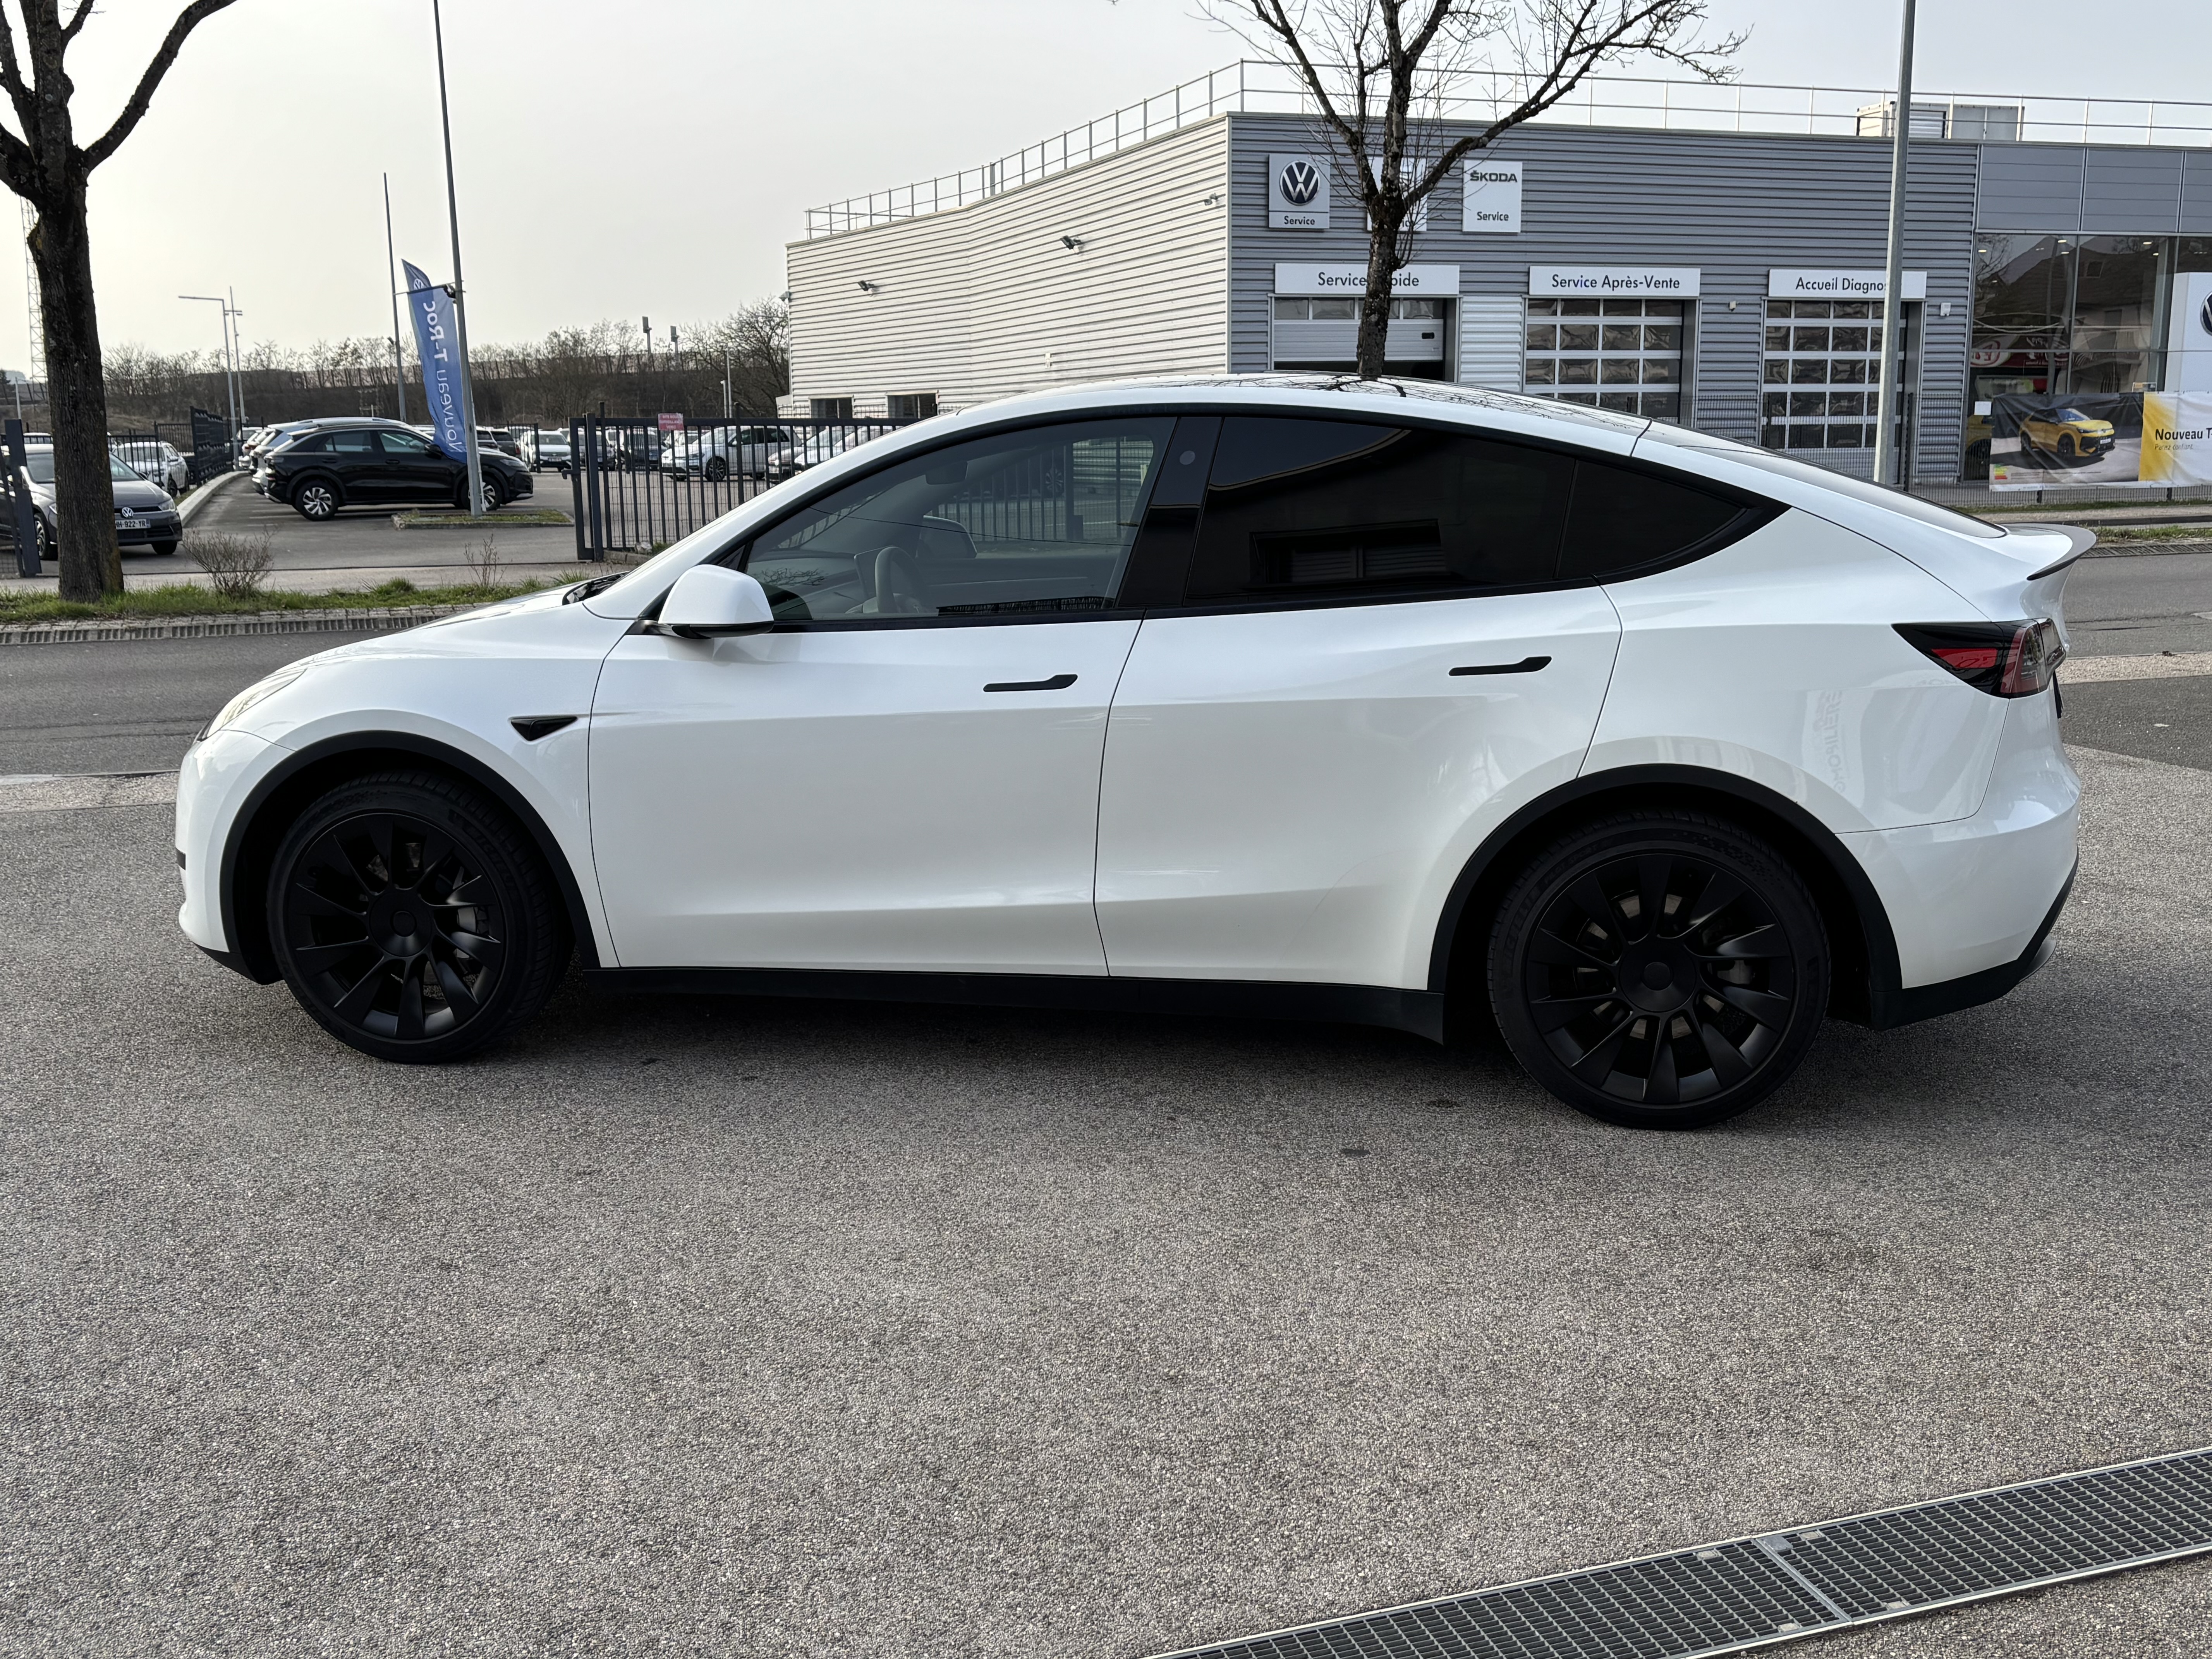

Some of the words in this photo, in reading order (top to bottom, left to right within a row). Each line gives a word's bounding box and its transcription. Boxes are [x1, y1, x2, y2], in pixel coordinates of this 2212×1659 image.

[1470, 170, 1518, 183] ŠKODA
[1284, 215, 1316, 225] Service
[1477, 211, 1509, 221] Service
[1318, 272, 1367, 286] Service
[1391, 272, 1419, 286] pide
[1552, 274, 1597, 288] Service
[1602, 275, 1680, 291] Après-Vente
[1795, 277, 1838, 290] Accueil
[1842, 277, 1886, 294] Diagno
[2155, 428, 2203, 440] Nouveau
[2206, 427, 2212, 439] T
